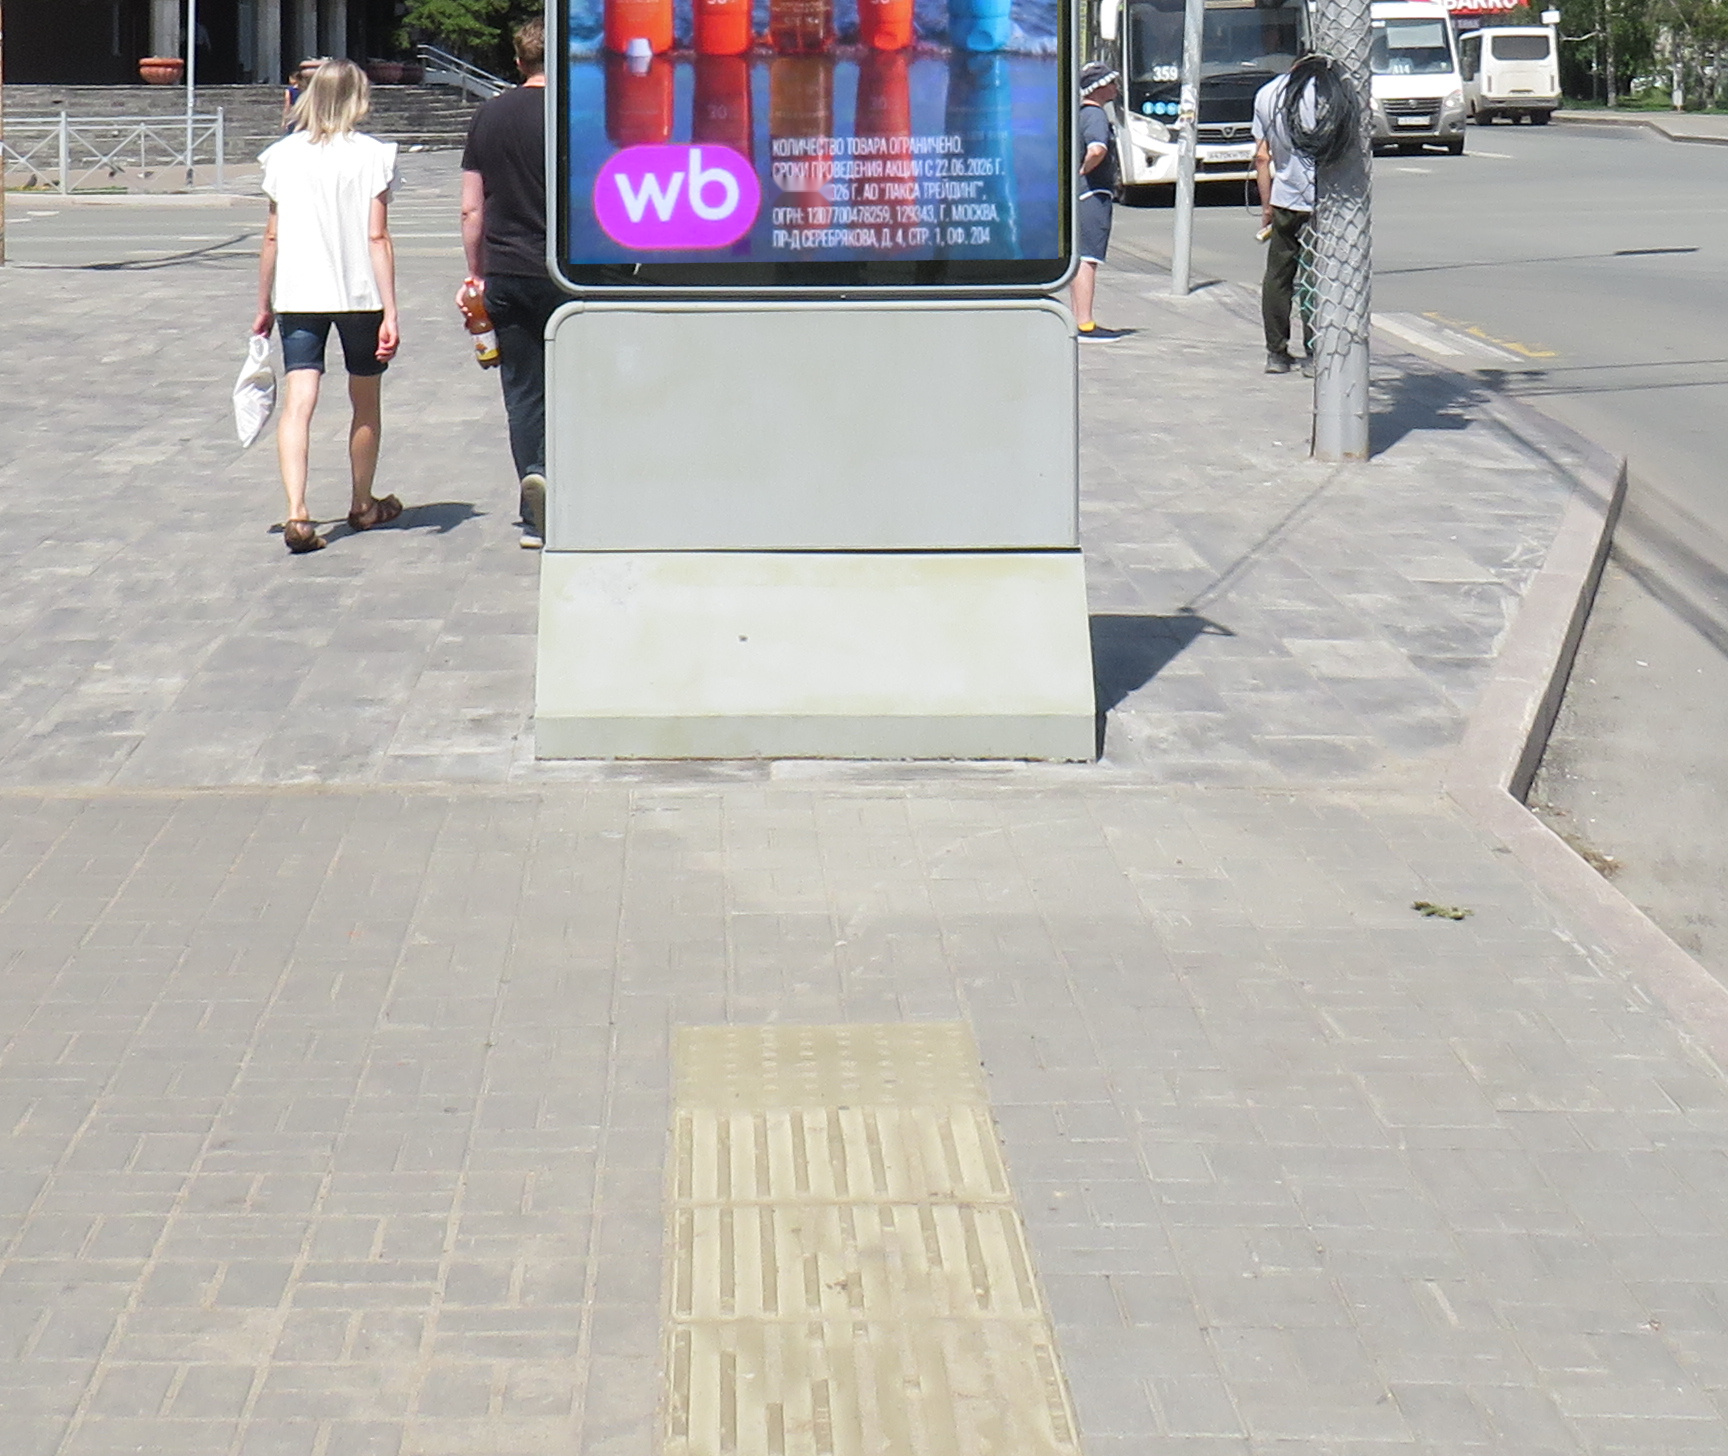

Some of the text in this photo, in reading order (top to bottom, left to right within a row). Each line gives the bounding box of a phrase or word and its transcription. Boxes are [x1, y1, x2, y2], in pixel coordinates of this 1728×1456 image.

[1152, 65, 1179, 82] 359
[772, 136, 964, 156] КОЛИЧЕСТВО ТОВАРА ОГРАНИЧЕНО.
[773, 161, 807, 178] СРОКИ
[811, 161, 883, 180] ПРОВЕДЕНИЯ
[884, 160, 923, 178] АКЦИИ
[925, 160, 934, 176] С
[613, 148, 740, 223] wb
[863, 183, 879, 200] АО
[970, 227, 991, 244] 204
